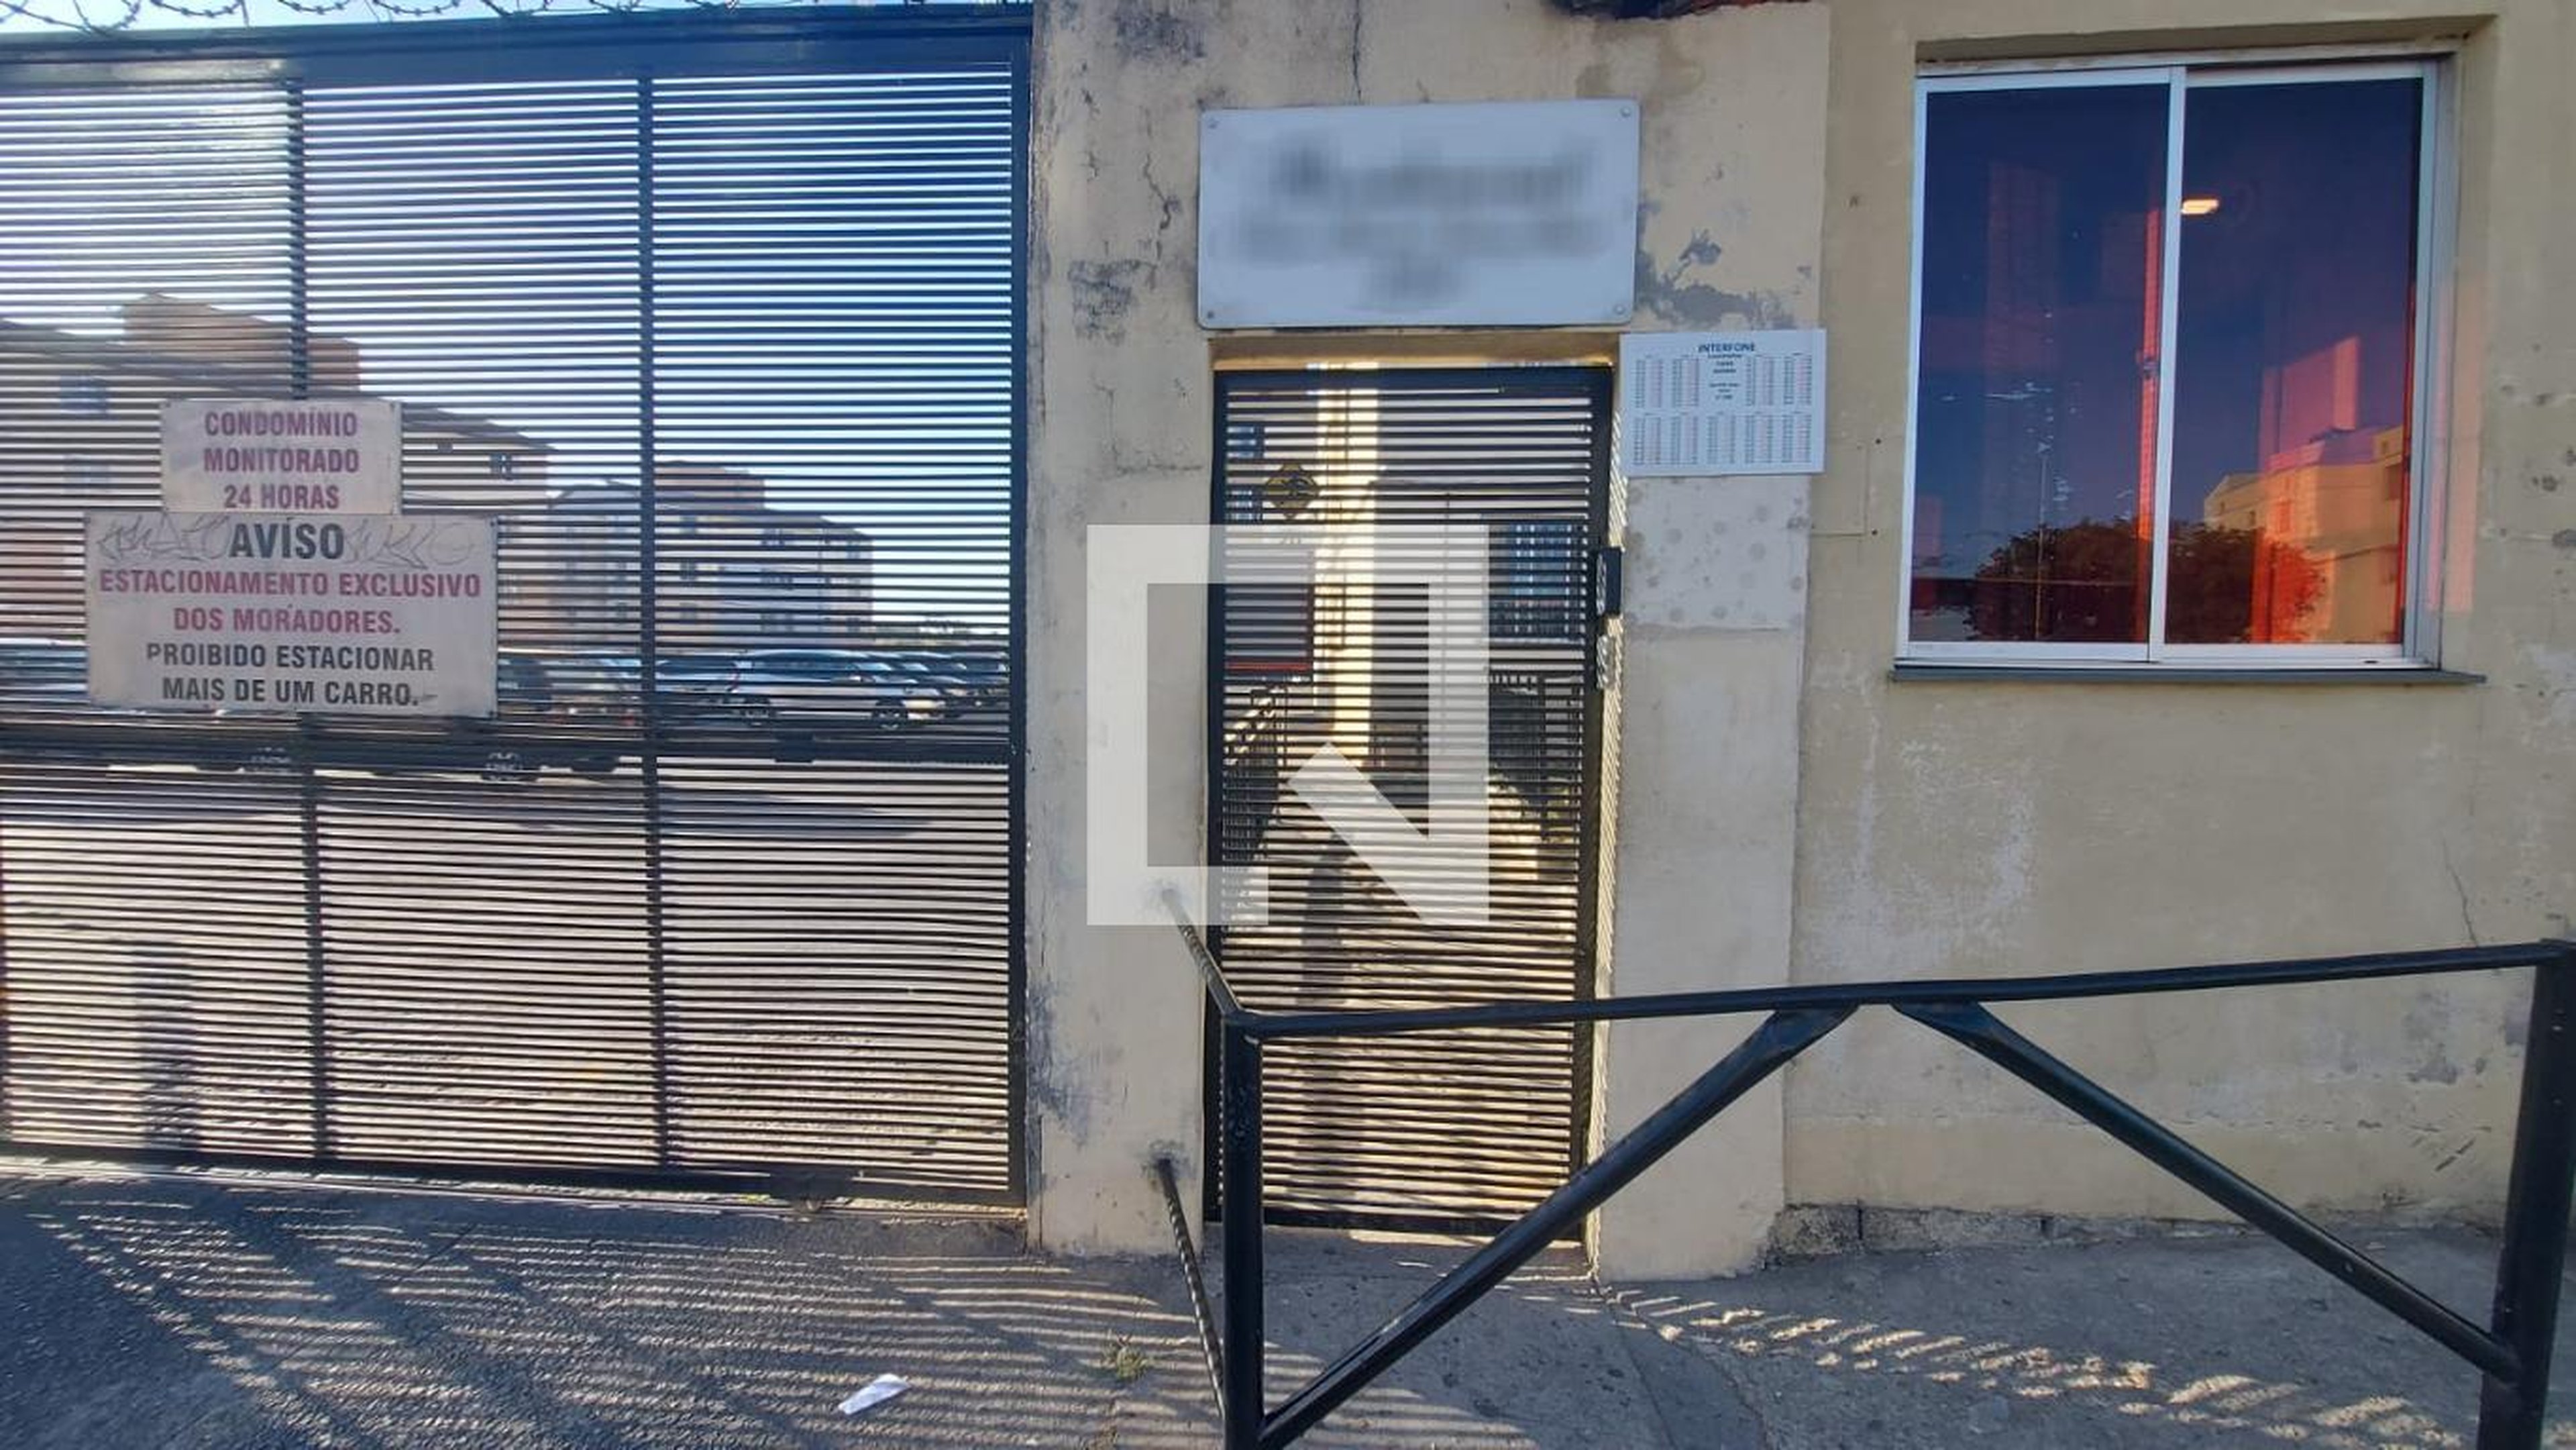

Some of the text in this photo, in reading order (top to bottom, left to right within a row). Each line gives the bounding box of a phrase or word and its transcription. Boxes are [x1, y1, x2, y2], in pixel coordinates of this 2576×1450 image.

[203, 448, 360, 472] MONITORADO
[223, 484, 340, 509] 24 HORAS
[100, 570, 481, 597] ESTACIONAMENTO EXCLUSIVO
[174, 607, 400, 634] DOS MORADORES.
[147, 643, 435, 672] PROIBIDO ESTACIONAR
[162, 677, 419, 707] MAIS DE UM CARRO.
